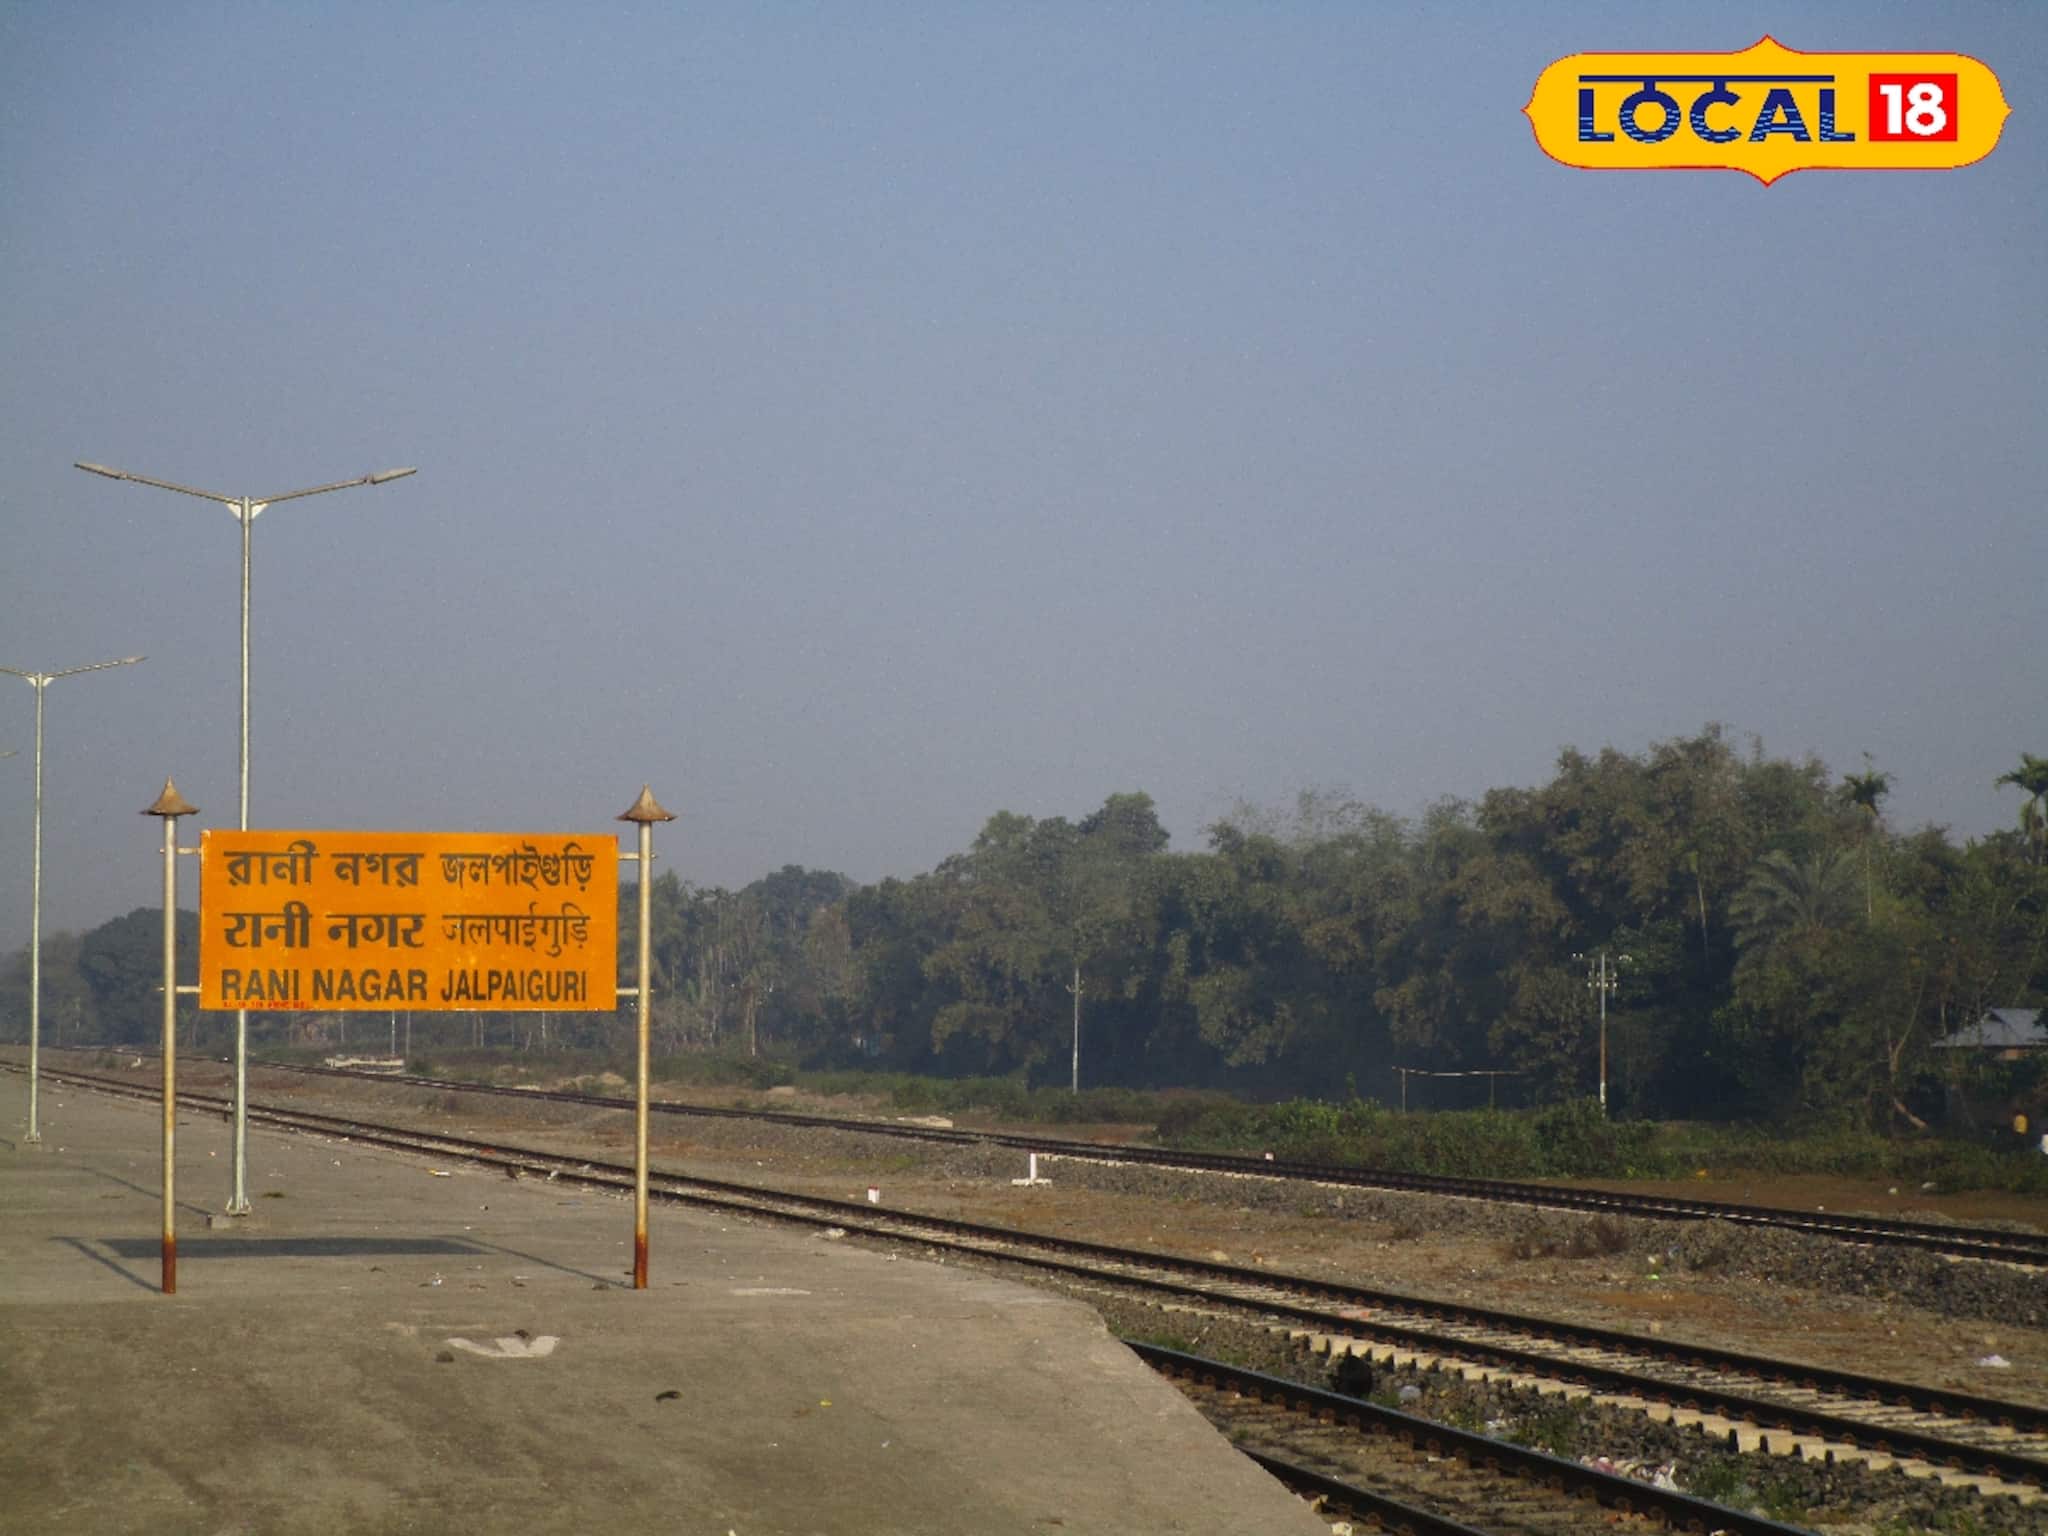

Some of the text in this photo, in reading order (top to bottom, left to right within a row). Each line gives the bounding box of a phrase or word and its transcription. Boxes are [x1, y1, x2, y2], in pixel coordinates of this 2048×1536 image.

[223, 839, 320, 887] রানী
[331, 852, 425, 887] নগর
[222, 900, 313, 949] रानी
[326, 912, 427, 949] नगर
[221, 968, 588, 1002] RANI NAGAR JALPAIGURI
